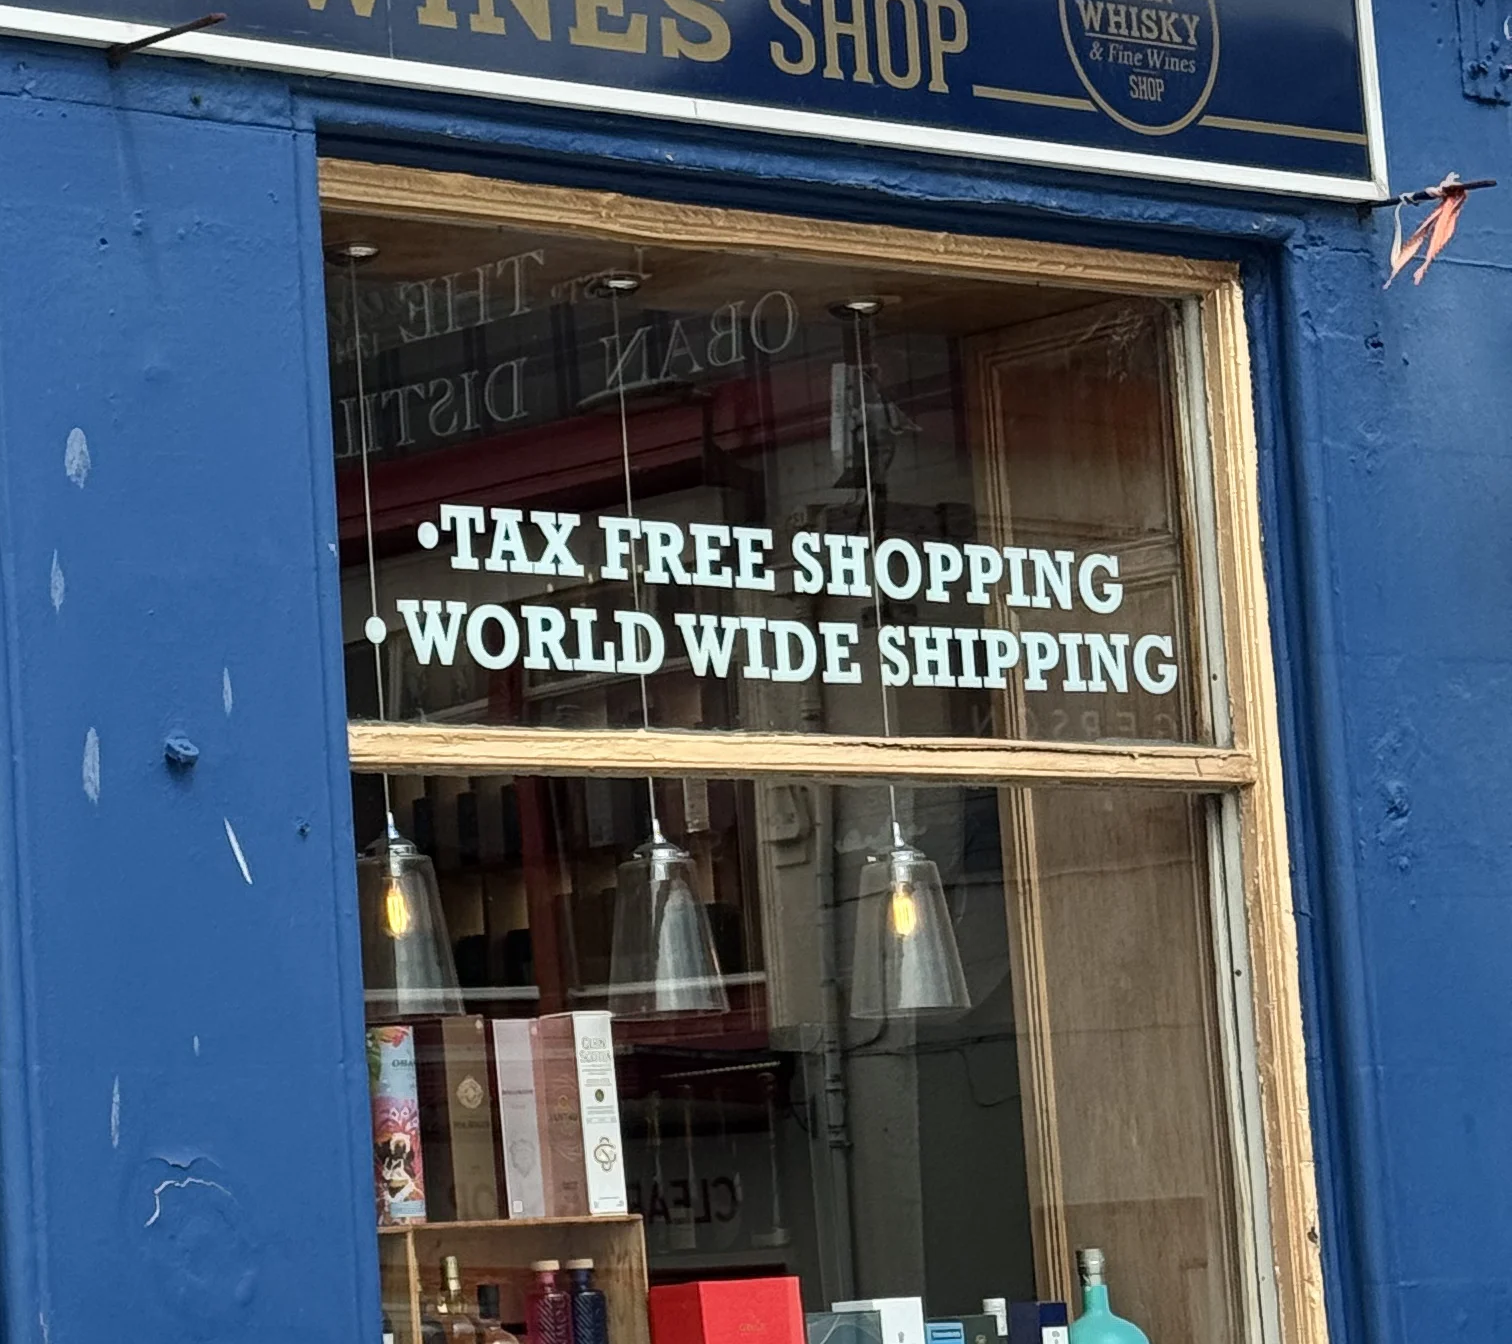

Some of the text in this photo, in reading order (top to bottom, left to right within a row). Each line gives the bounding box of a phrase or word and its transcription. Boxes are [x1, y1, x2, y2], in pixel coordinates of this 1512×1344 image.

[1089, 40, 1197, 74] & Fine Wines
[1129, 74, 1165, 102] SHOP
[440, 503, 1124, 615] TAX FREE SHOPPING
[396, 598, 1180, 696] WORLD WIDE SHIPPING
